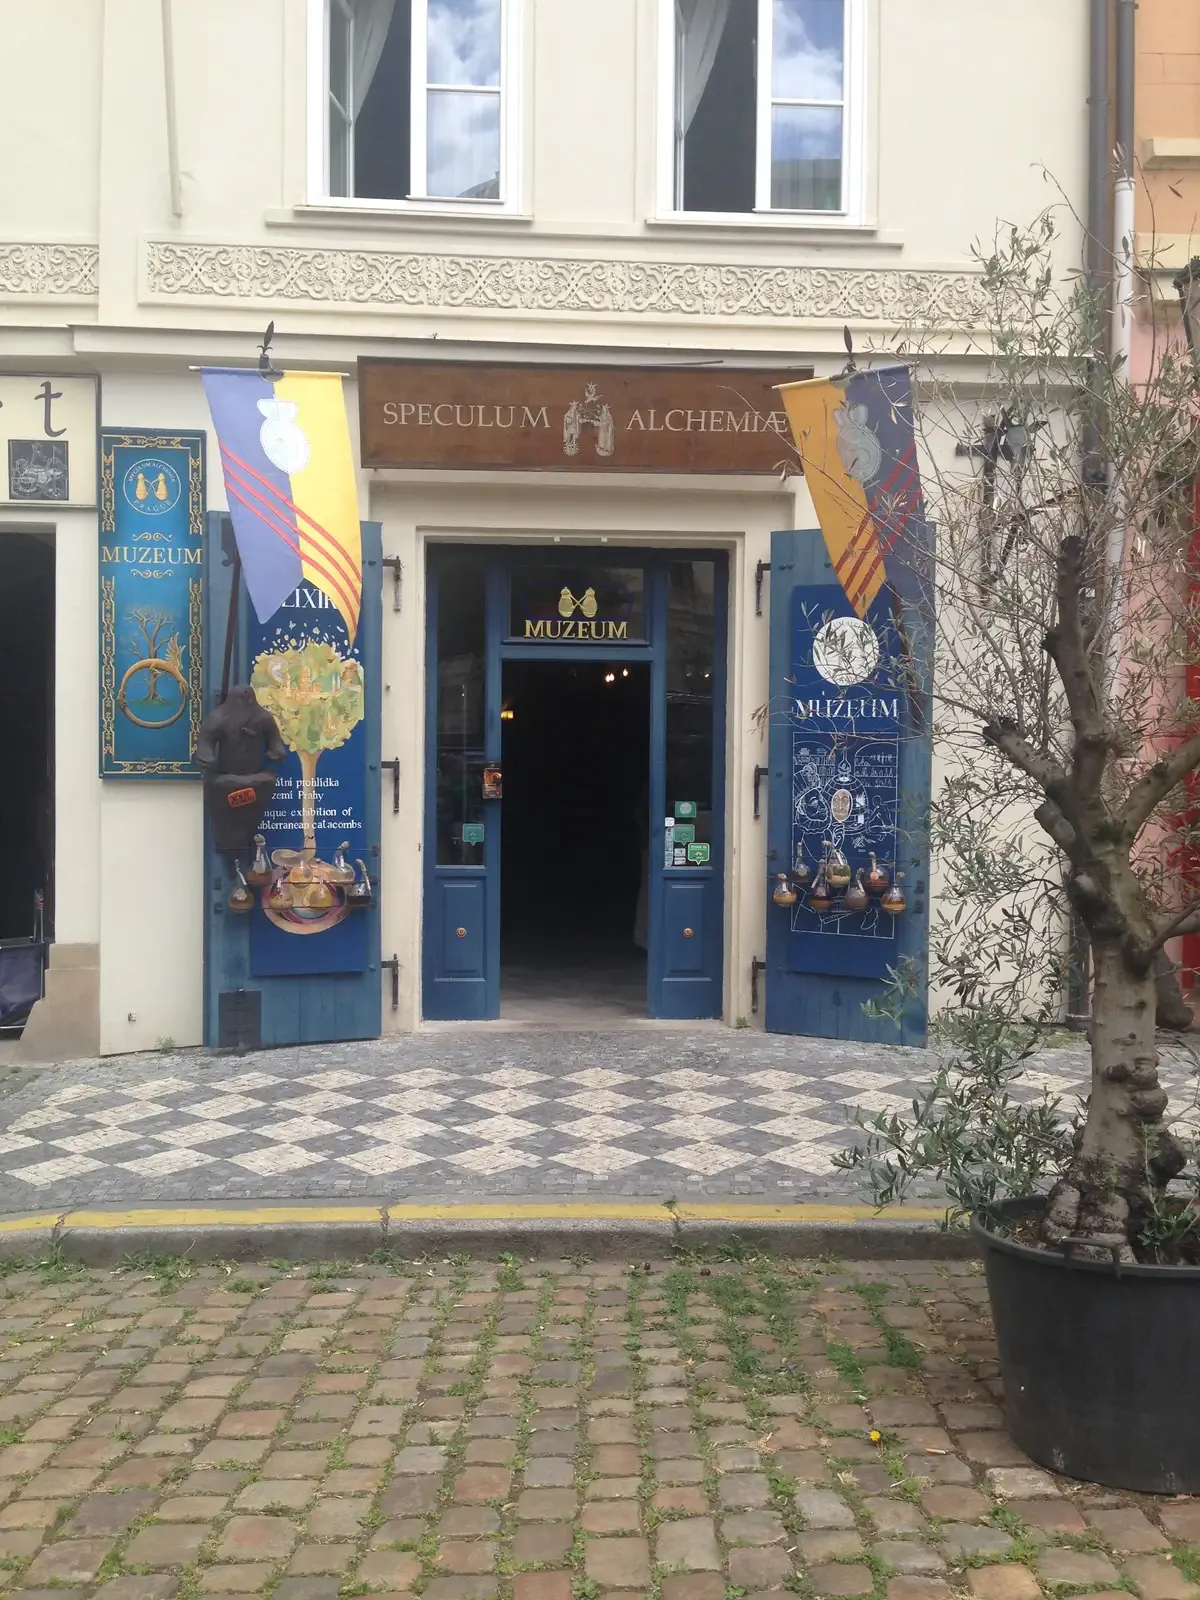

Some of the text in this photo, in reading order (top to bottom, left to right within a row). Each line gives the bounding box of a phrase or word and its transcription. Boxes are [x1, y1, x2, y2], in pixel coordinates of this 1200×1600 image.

[383, 402, 551, 429] SPECULUM
[101, 546, 203, 565] MUZEUM
[524, 619, 628, 639] MUZEUM
[795, 698, 899, 718] MUZEUM
[296, 777, 339, 788] prohlídka
[298, 790, 324, 802] Prahy
[291, 807, 337, 817] exhibition
[342, 806, 353, 817] of
[312, 820, 362, 830] catacombs
